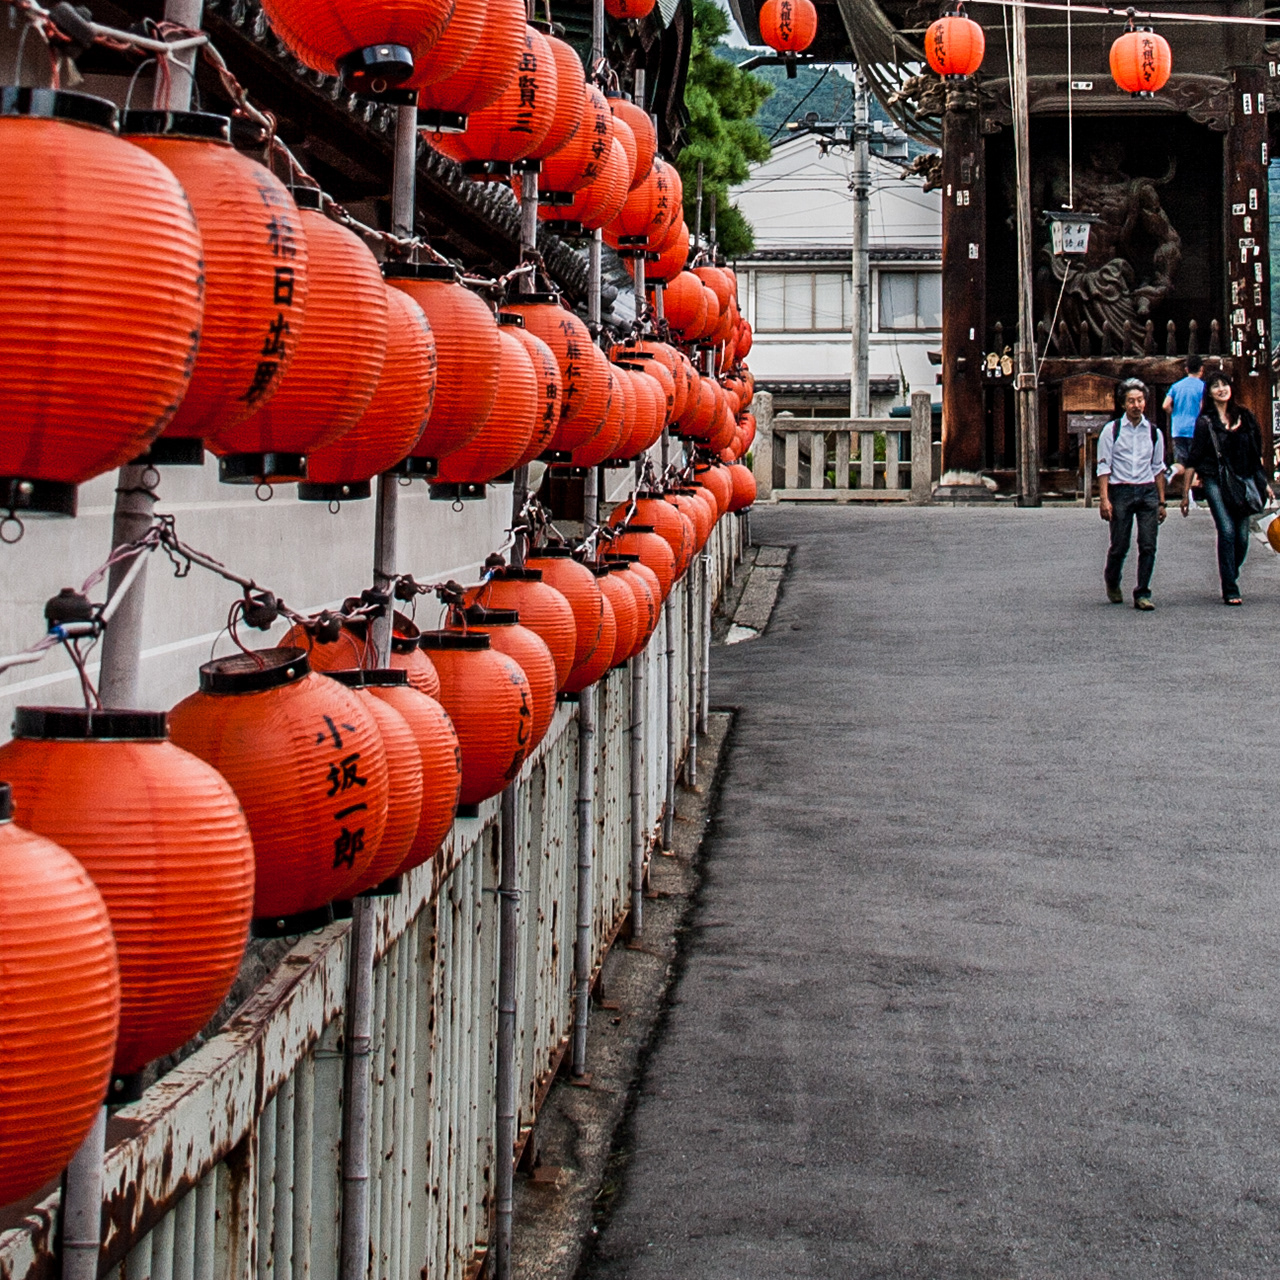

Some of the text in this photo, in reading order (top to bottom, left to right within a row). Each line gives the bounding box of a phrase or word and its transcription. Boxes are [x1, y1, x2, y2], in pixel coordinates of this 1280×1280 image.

[1141, 38, 1156, 83] 先祖代々
[315, 714, 368, 869] 小坂一郎
